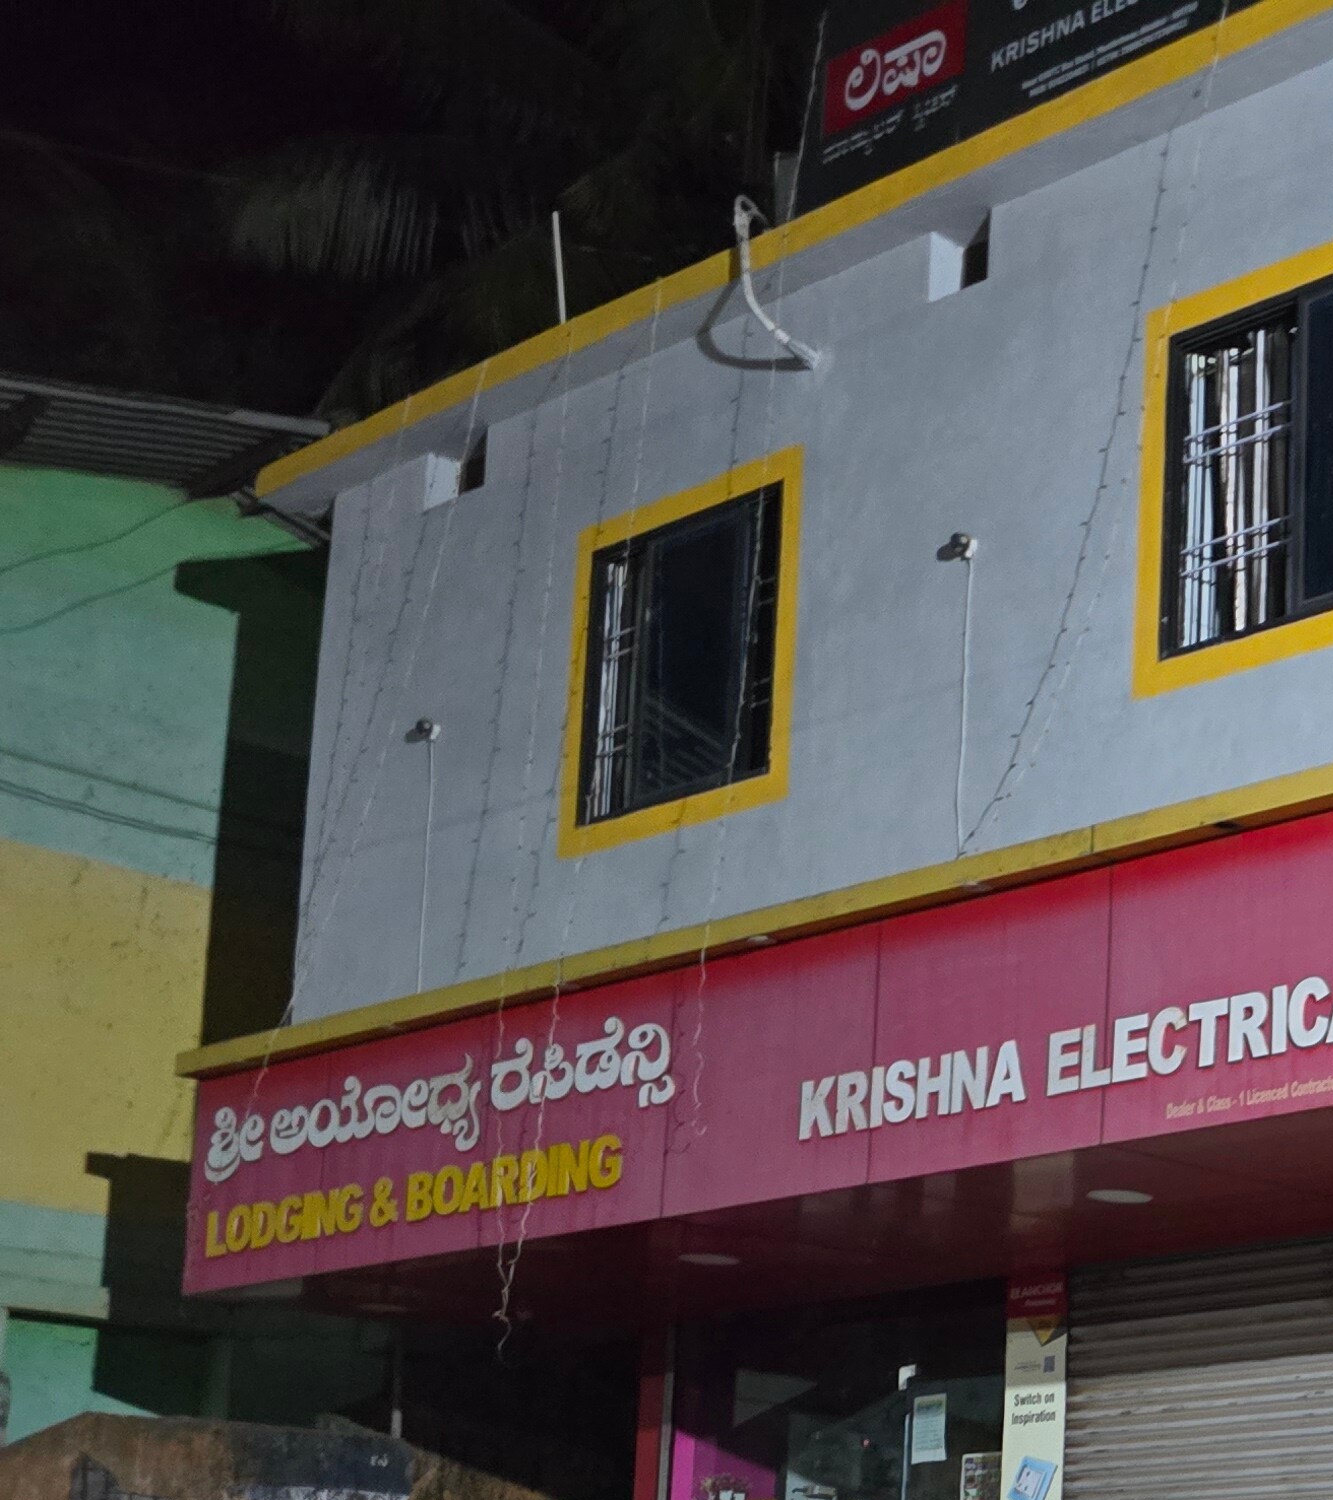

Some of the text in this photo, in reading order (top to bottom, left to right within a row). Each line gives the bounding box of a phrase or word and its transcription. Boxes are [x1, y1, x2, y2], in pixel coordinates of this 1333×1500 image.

[990, 11, 1087, 73] KRISHNA
[797, 1038, 1026, 1142] KRISHNA
[204, 1106, 264, 1182] ಶ್ರೀ
[204, 1134, 623, 1259] LODGING & BOARDING
[1011, 1411, 1056, 1426] Inspiration
[1014, 1393, 1055, 1407] Switch on
